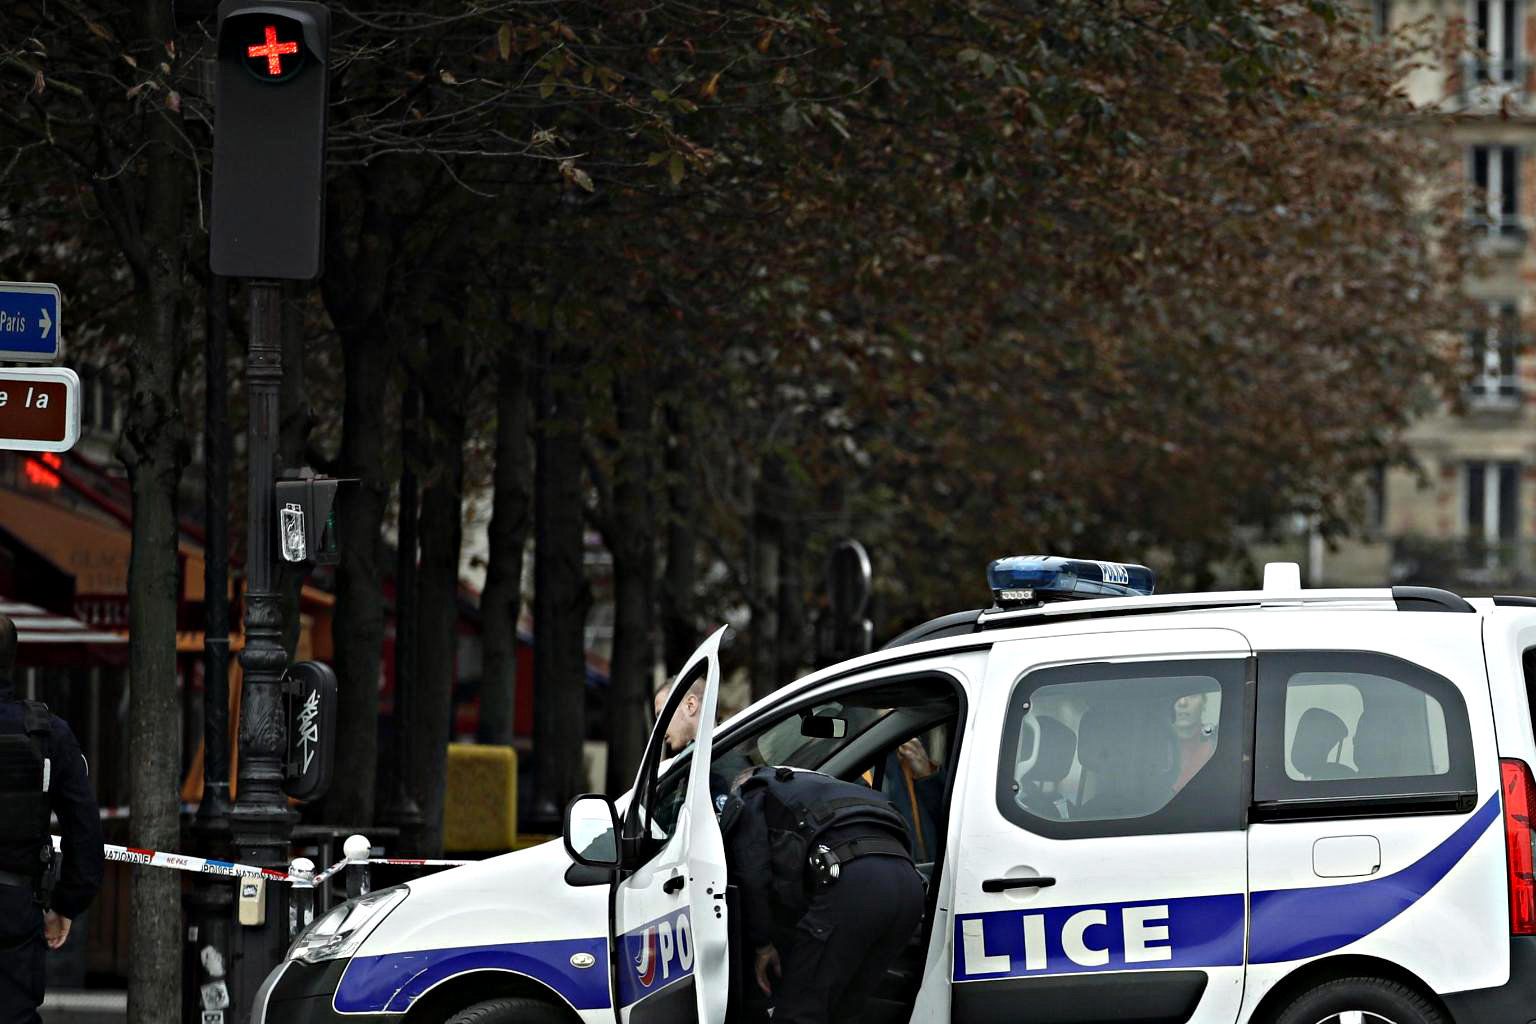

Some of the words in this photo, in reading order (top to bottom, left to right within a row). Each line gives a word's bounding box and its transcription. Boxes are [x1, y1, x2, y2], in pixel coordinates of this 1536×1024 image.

[25, 387, 49, 409] la
[658, 913, 694, 979] PO
[962, 905, 1172, 975] LICE
